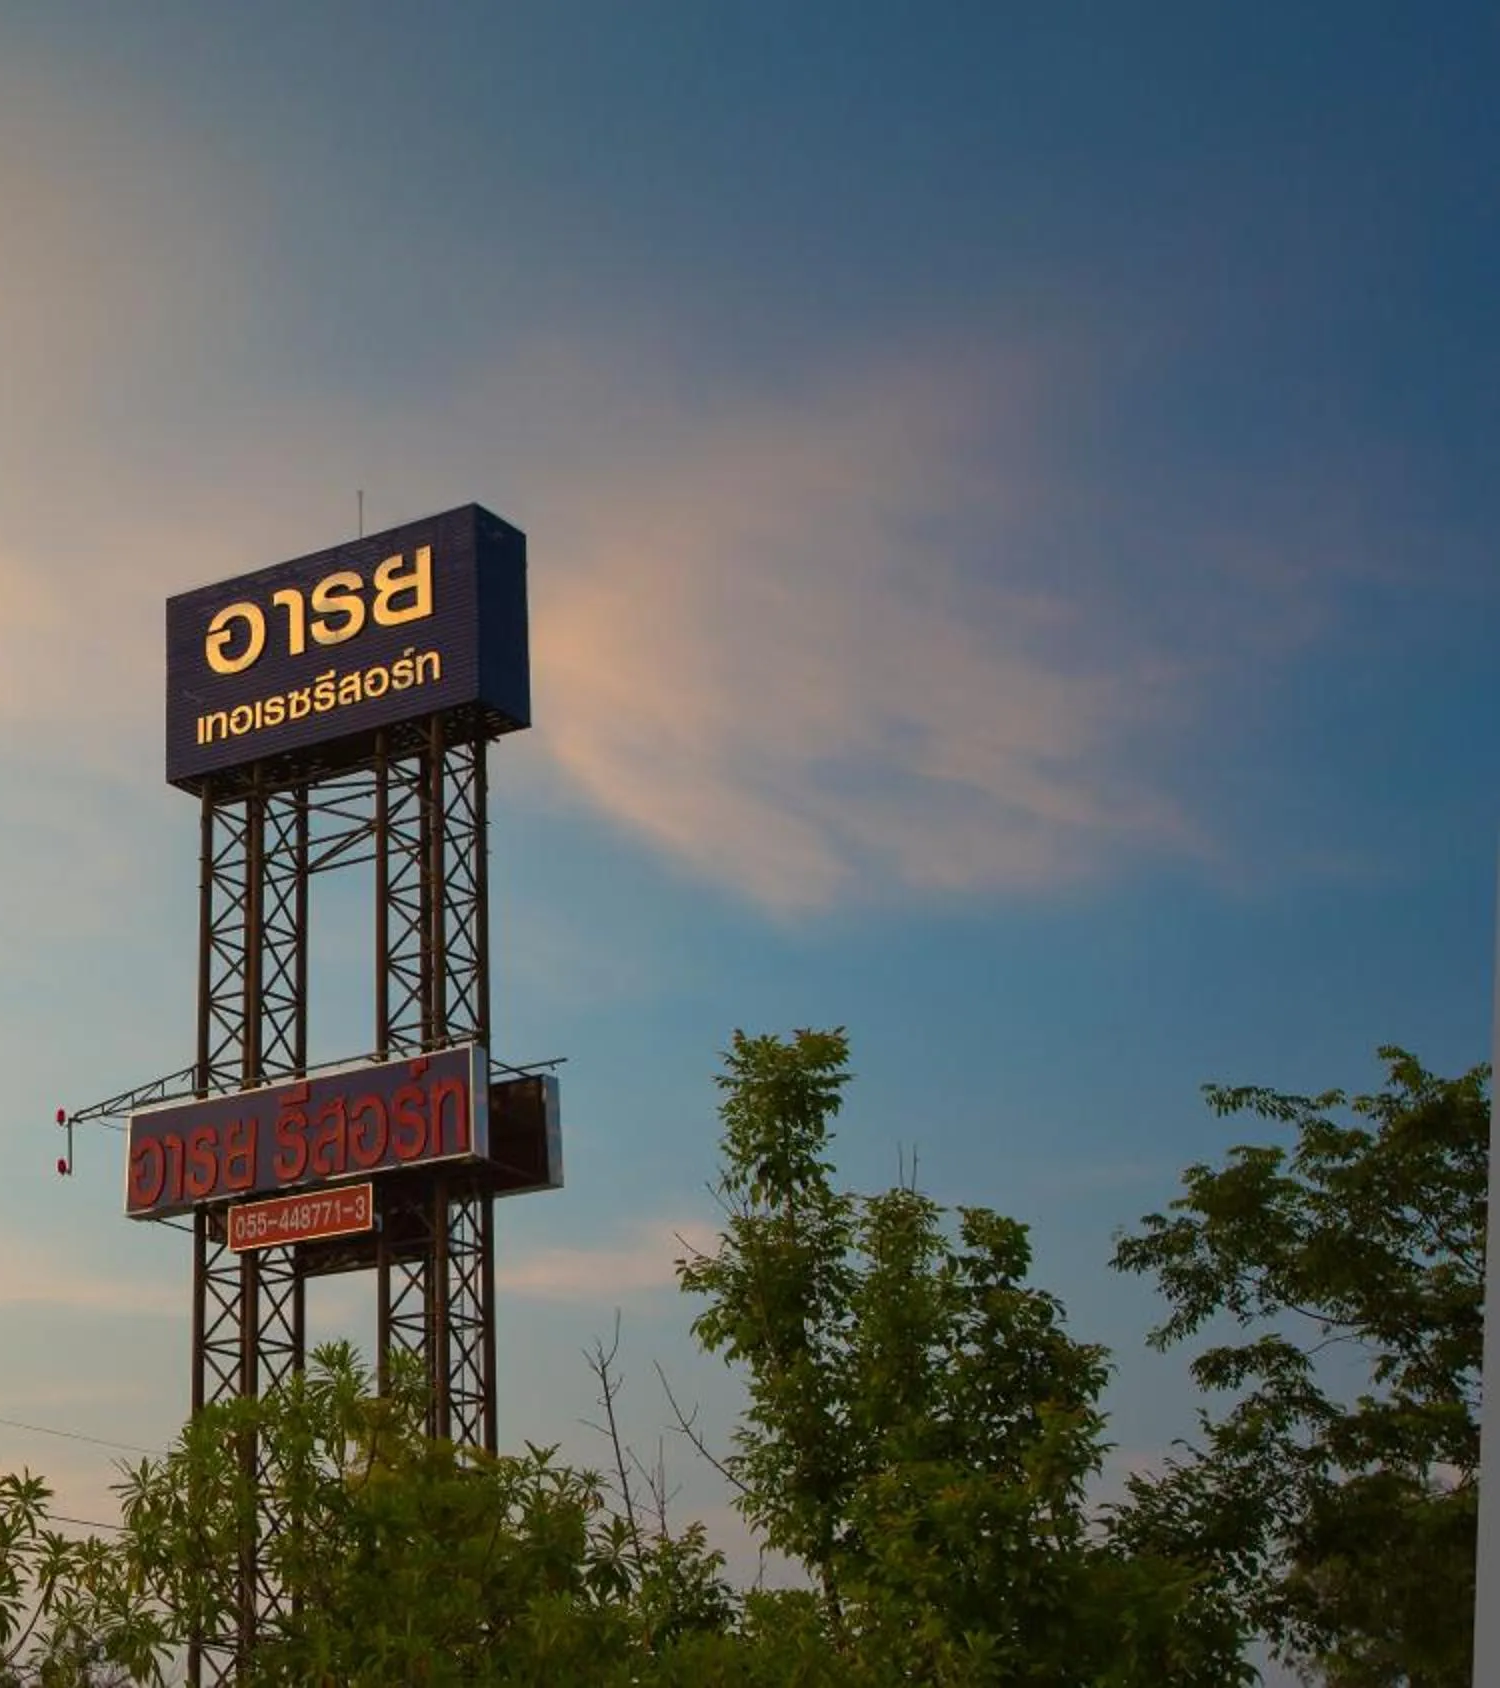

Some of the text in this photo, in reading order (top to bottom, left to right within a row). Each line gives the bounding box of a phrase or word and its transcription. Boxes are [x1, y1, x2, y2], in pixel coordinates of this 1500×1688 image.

[206, 545, 433, 675] อารย
[129, 1057, 470, 1208] อารย รีสอร์ท
[235, 1196, 365, 1240] 055-448771-3
